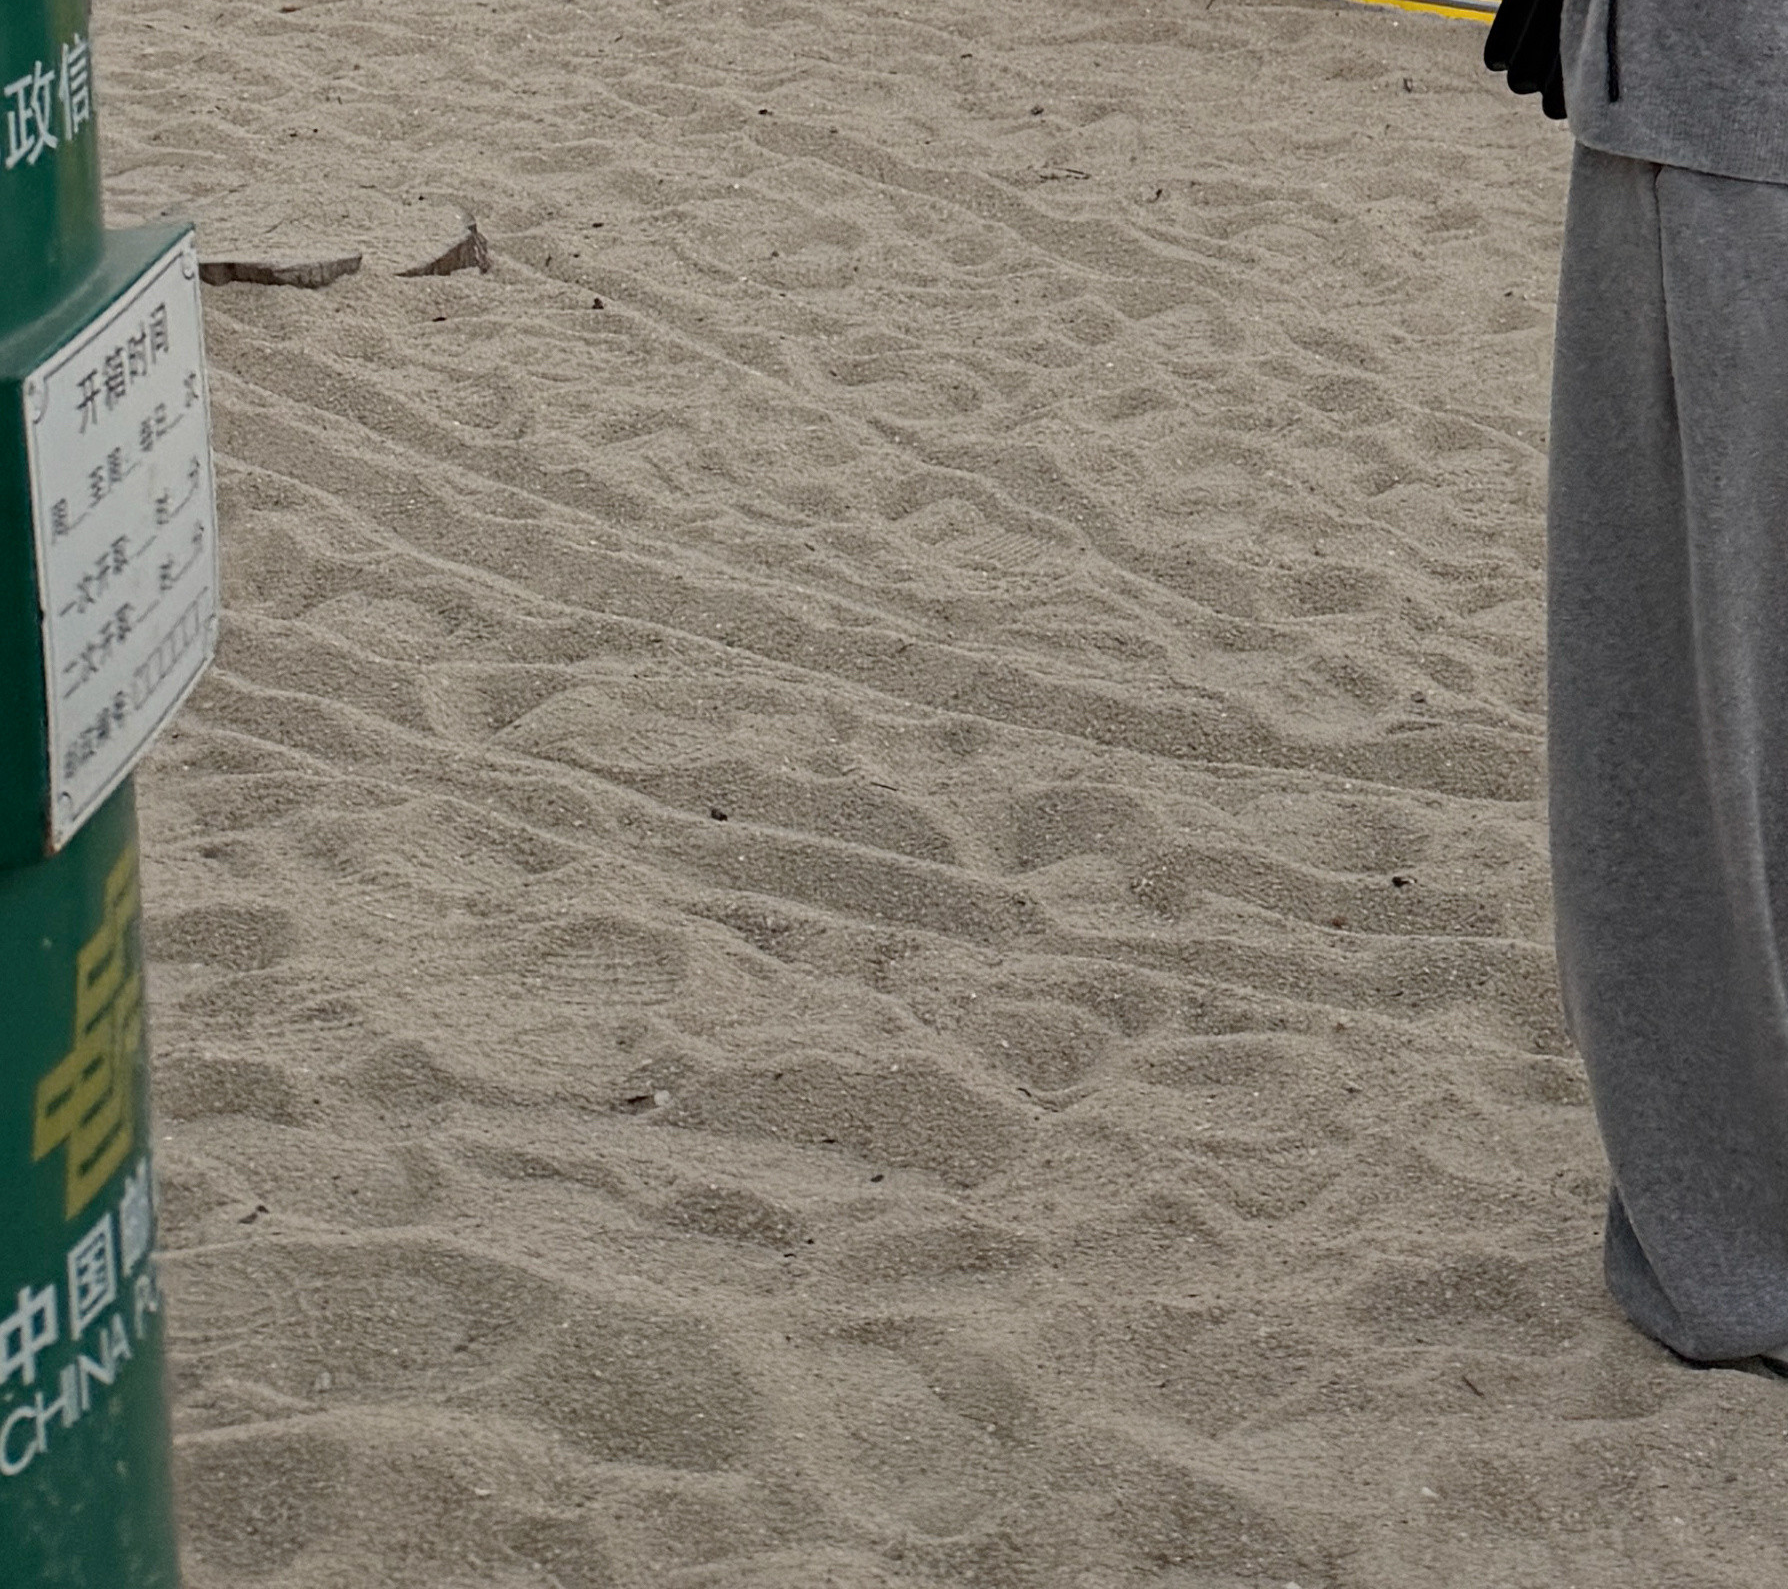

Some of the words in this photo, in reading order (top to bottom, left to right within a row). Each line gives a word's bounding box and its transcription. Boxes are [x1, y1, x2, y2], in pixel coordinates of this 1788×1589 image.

[3, 32, 91, 170] 政信
[76, 301, 170, 435] 开箱时间
[0, 1312, 133, 1476] CHINA
